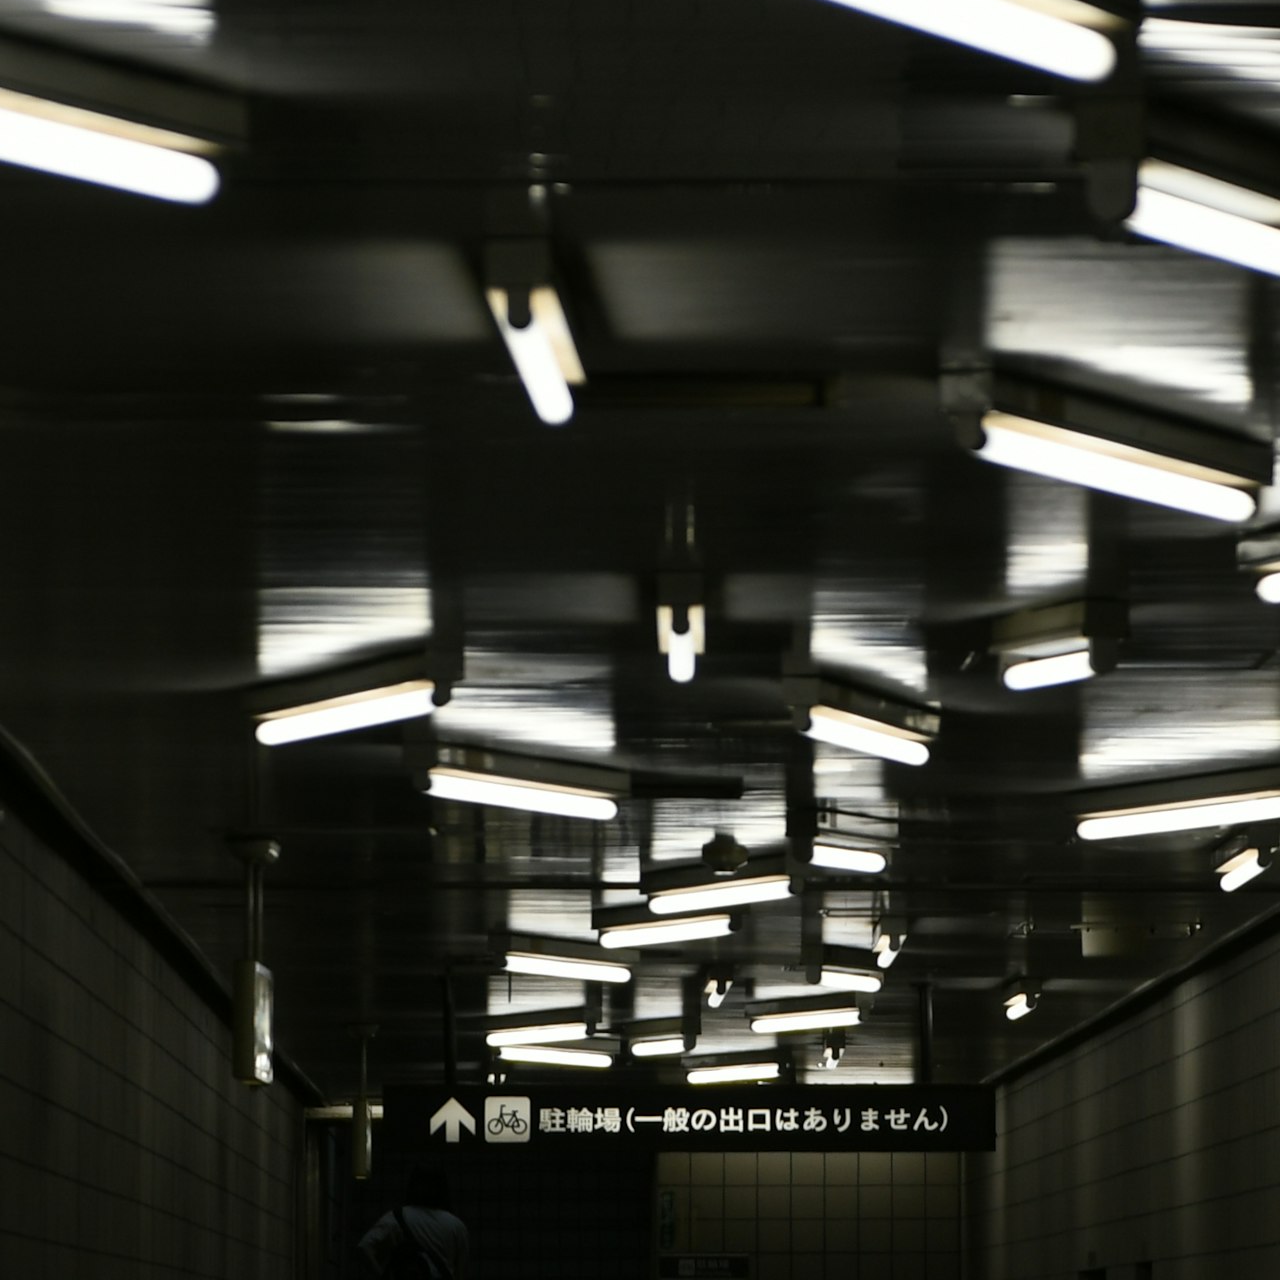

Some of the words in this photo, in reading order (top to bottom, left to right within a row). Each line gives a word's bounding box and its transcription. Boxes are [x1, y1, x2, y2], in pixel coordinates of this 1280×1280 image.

[538, 1105, 948, 1133] 駐輪場(一般の出口はありません)
